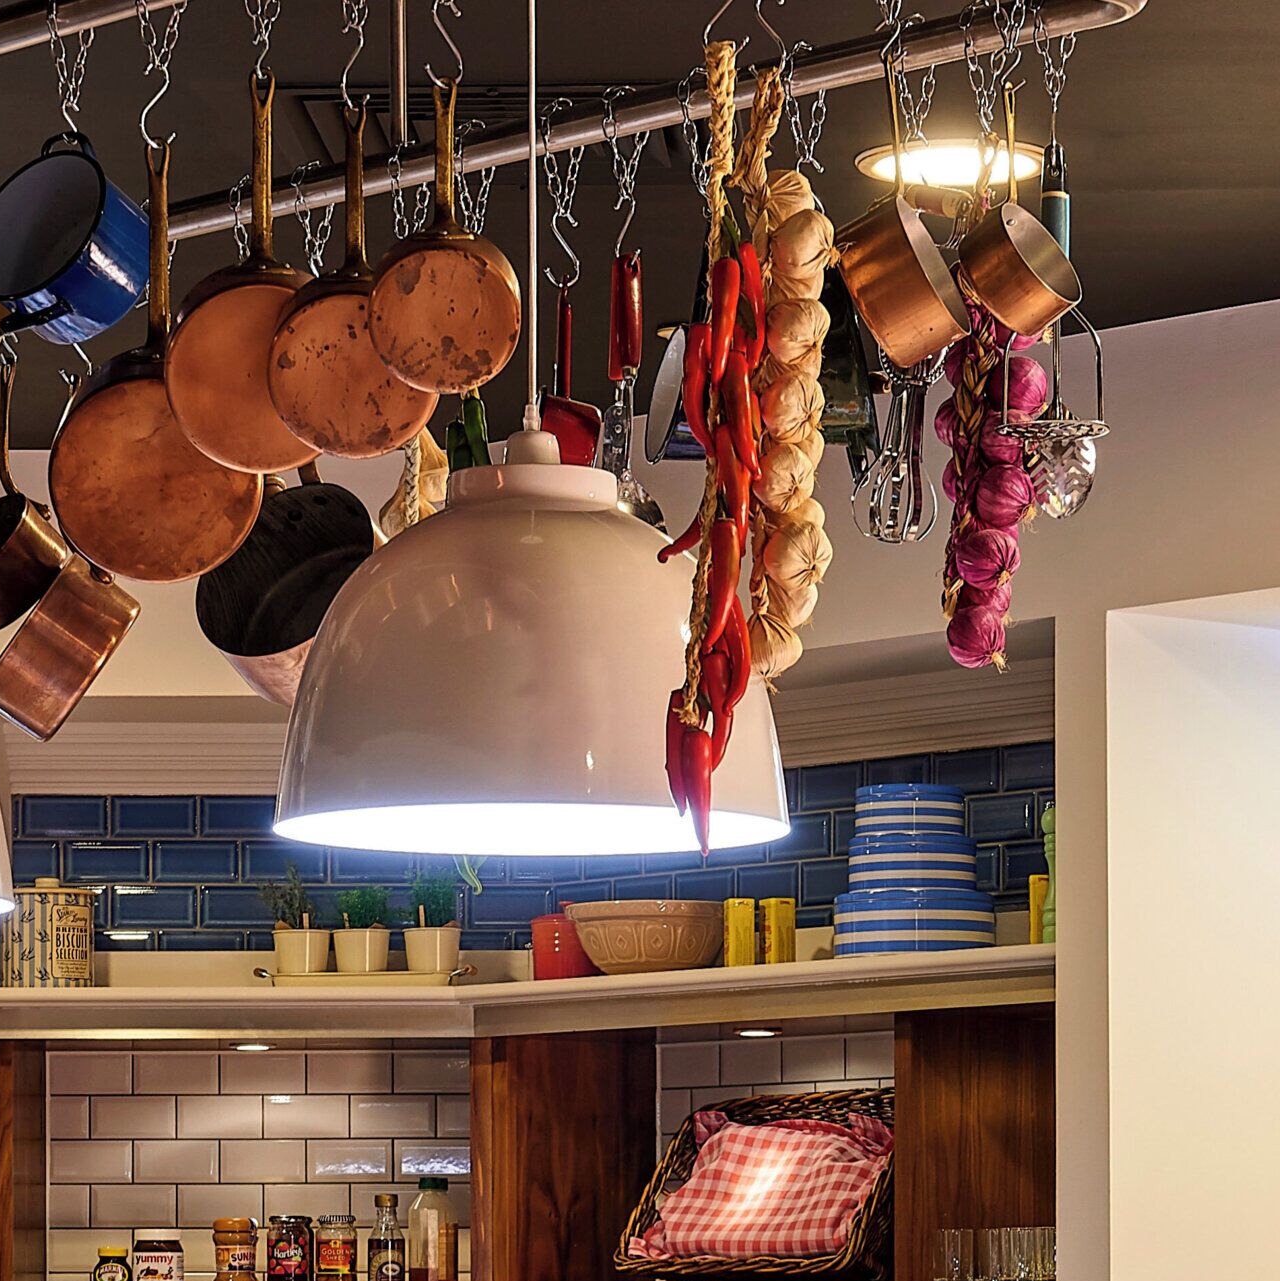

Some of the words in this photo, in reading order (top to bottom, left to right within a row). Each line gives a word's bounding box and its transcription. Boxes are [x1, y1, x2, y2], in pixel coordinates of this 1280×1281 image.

[56, 933, 87, 948] BISCUIT
[56, 948, 87, 960] SELECTION
[135, 1254, 174, 1265] yummy
